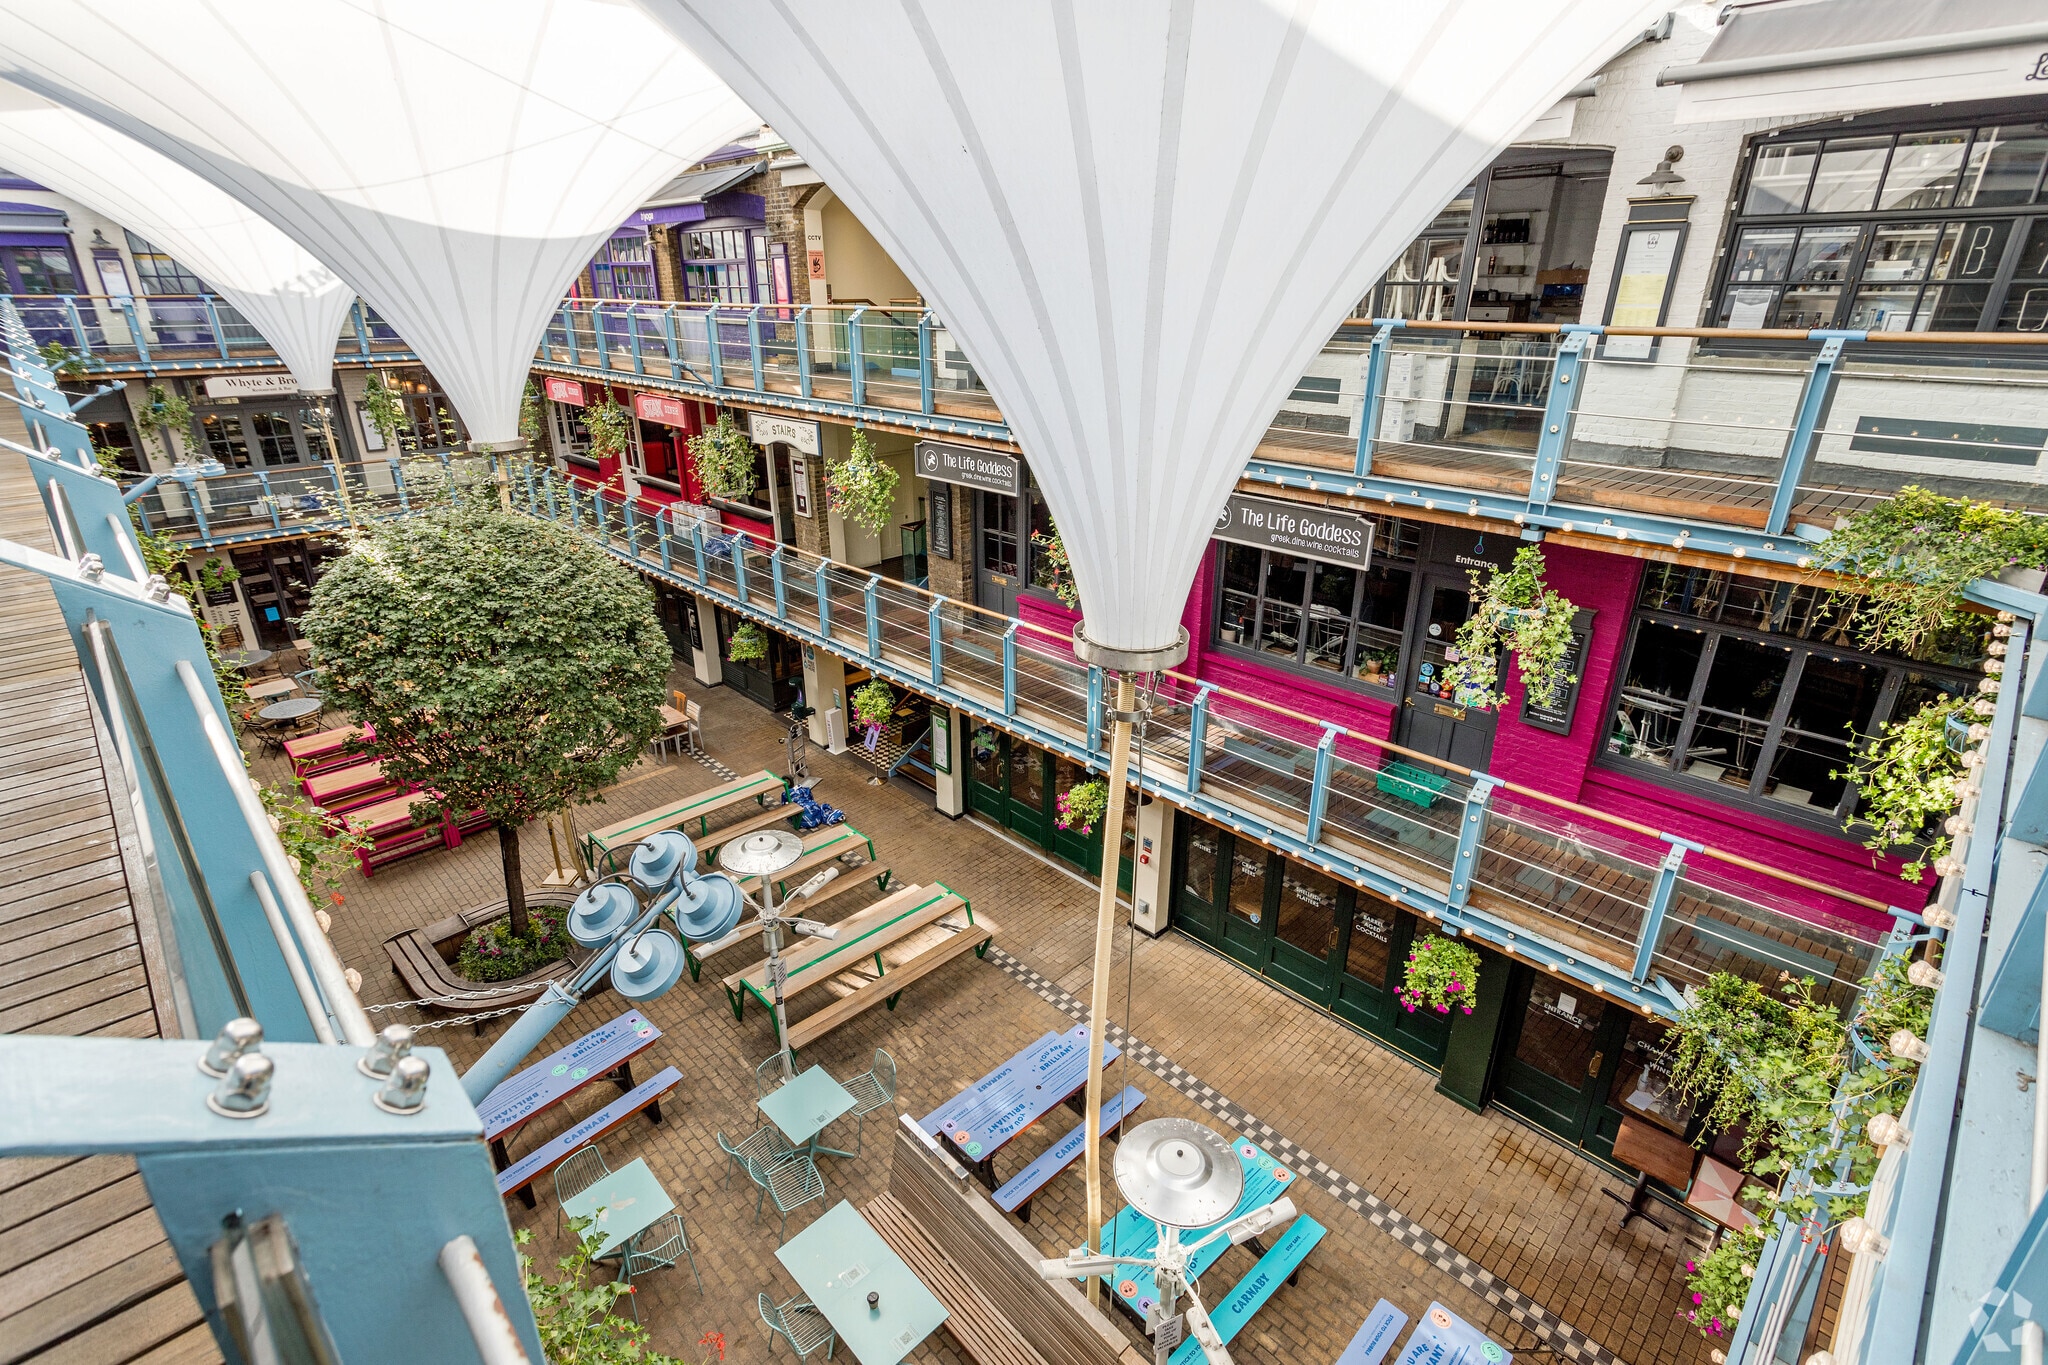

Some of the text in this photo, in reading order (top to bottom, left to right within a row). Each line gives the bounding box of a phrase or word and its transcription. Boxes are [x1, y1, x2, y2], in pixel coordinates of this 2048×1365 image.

[225, 378, 262, 389] Whyte
[265, 377, 276, 386] &
[771, 424, 797, 440] STAIRS
[942, 453, 1013, 478] The Life Goddess
[1241, 507, 1362, 546] The Life Goddess
[1455, 555, 1499, 569] Entrance
[1192, 841, 1211, 854] OYSTERS
[1241, 861, 1258, 872] CRAFT
[1241, 867, 1256, 878] BEERS
[1296, 886, 1322, 902] SHELLFISH
[1296, 893, 1319, 907] PLATTERS
[1363, 914, 1384, 928] BARREL
[1364, 922, 1381, 933] AGED
[1355, 924, 1388, 943] COCKTAILS
[1543, 1002, 1584, 1025] ENTRANCE
[572, 1030, 617, 1058] BRILLIANT
[575, 1030, 606, 1050] YOU ARE
[1039, 1051, 1051, 1063] YOU
[1049, 1044, 1062, 1052] ARE
[1039, 1044, 1075, 1071] BRILLIANT
[977, 1067, 1012, 1093] CARNABY
[489, 1091, 539, 1125] BRILLIANT
[500, 1100, 537, 1125] YOU ARE
[563, 1112, 611, 1144] CARNABY
[987, 1103, 1026, 1134] BRILLIANT
[999, 1112, 1027, 1135] YOU ARE
[1003, 1190, 1014, 1199] STICK
[1019, 1177, 1029, 1187] YOUR
[1027, 1168, 1040, 1180] BUBBLE
[1231, 1272, 1270, 1314] CARNABY
[1384, 1314, 1394, 1326] STICK
[1414, 1343, 1429, 1358] ARE
